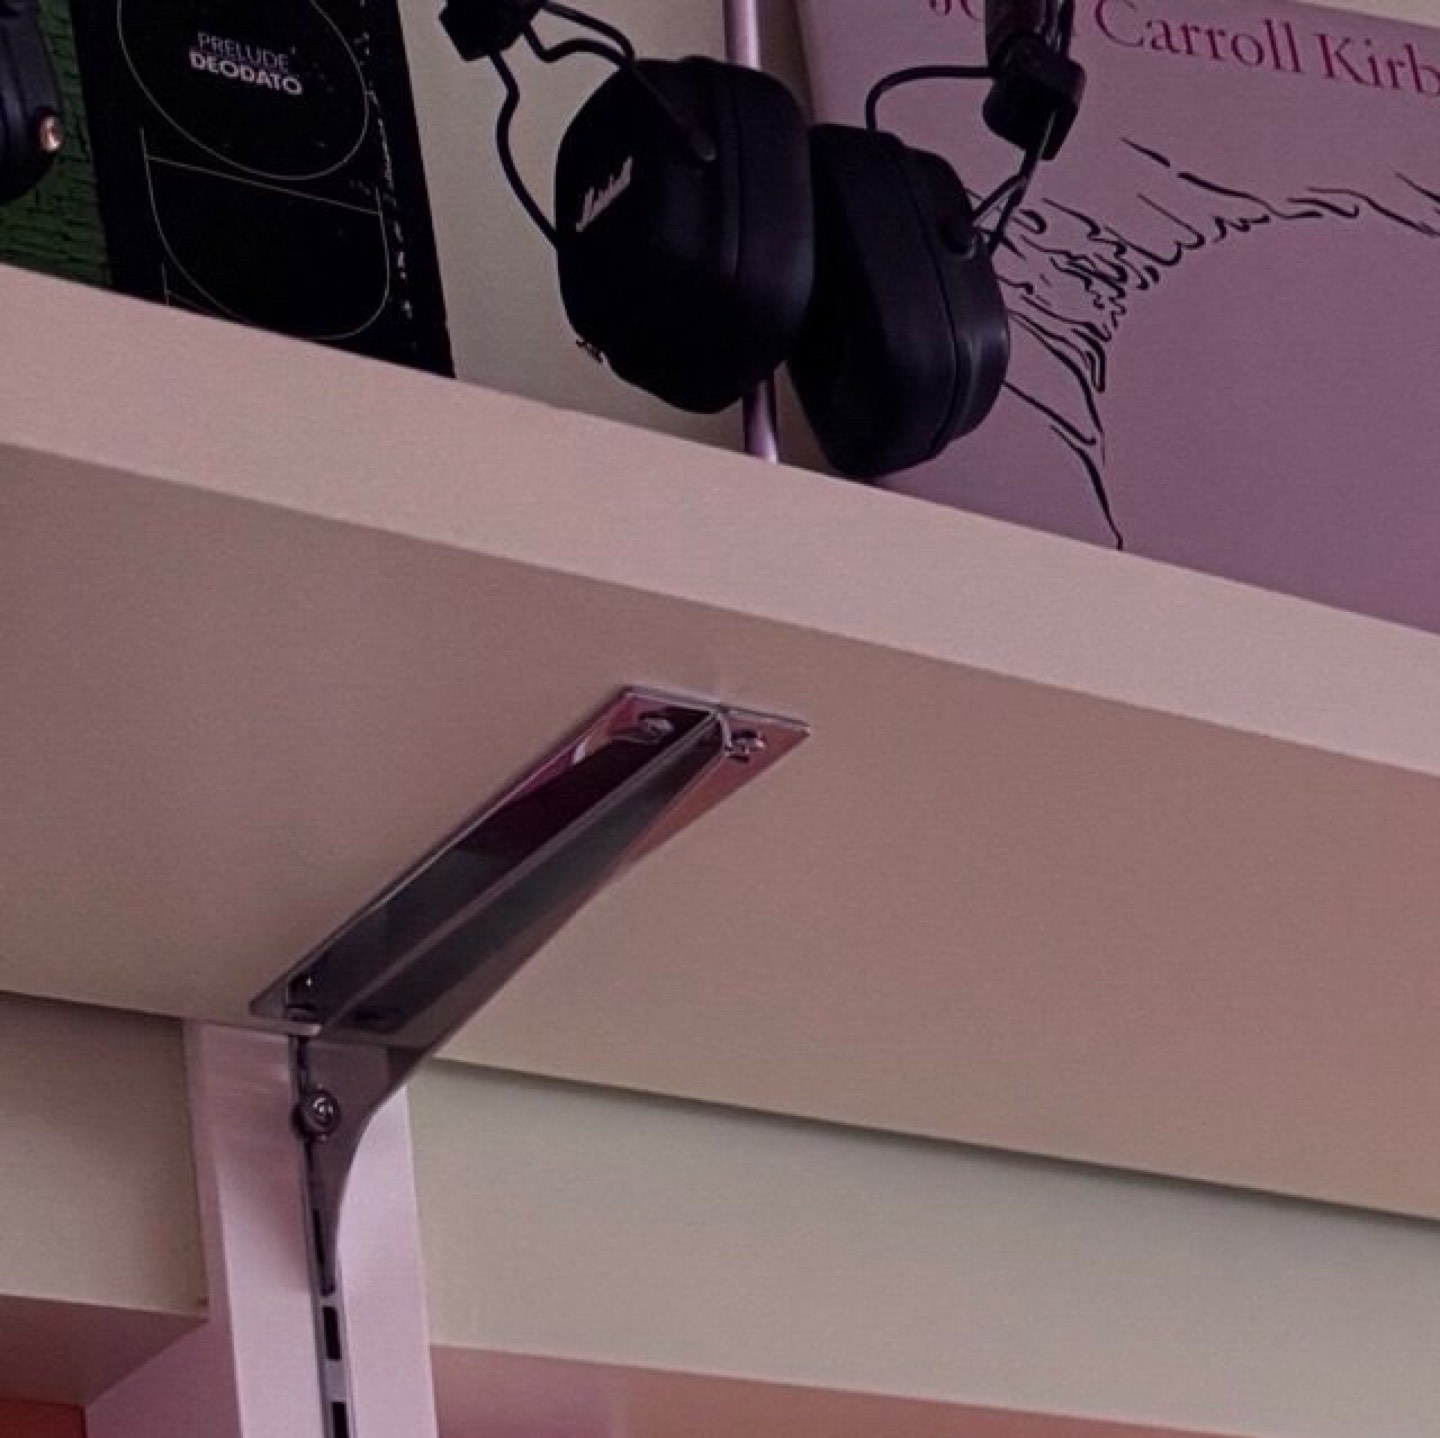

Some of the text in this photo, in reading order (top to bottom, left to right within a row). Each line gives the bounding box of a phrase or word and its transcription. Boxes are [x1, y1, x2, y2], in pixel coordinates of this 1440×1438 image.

[197, 32, 290, 70] PRELUDE
[1094, 0, 1303, 74] Carroll
[189, 50, 303, 98] DEODATO
